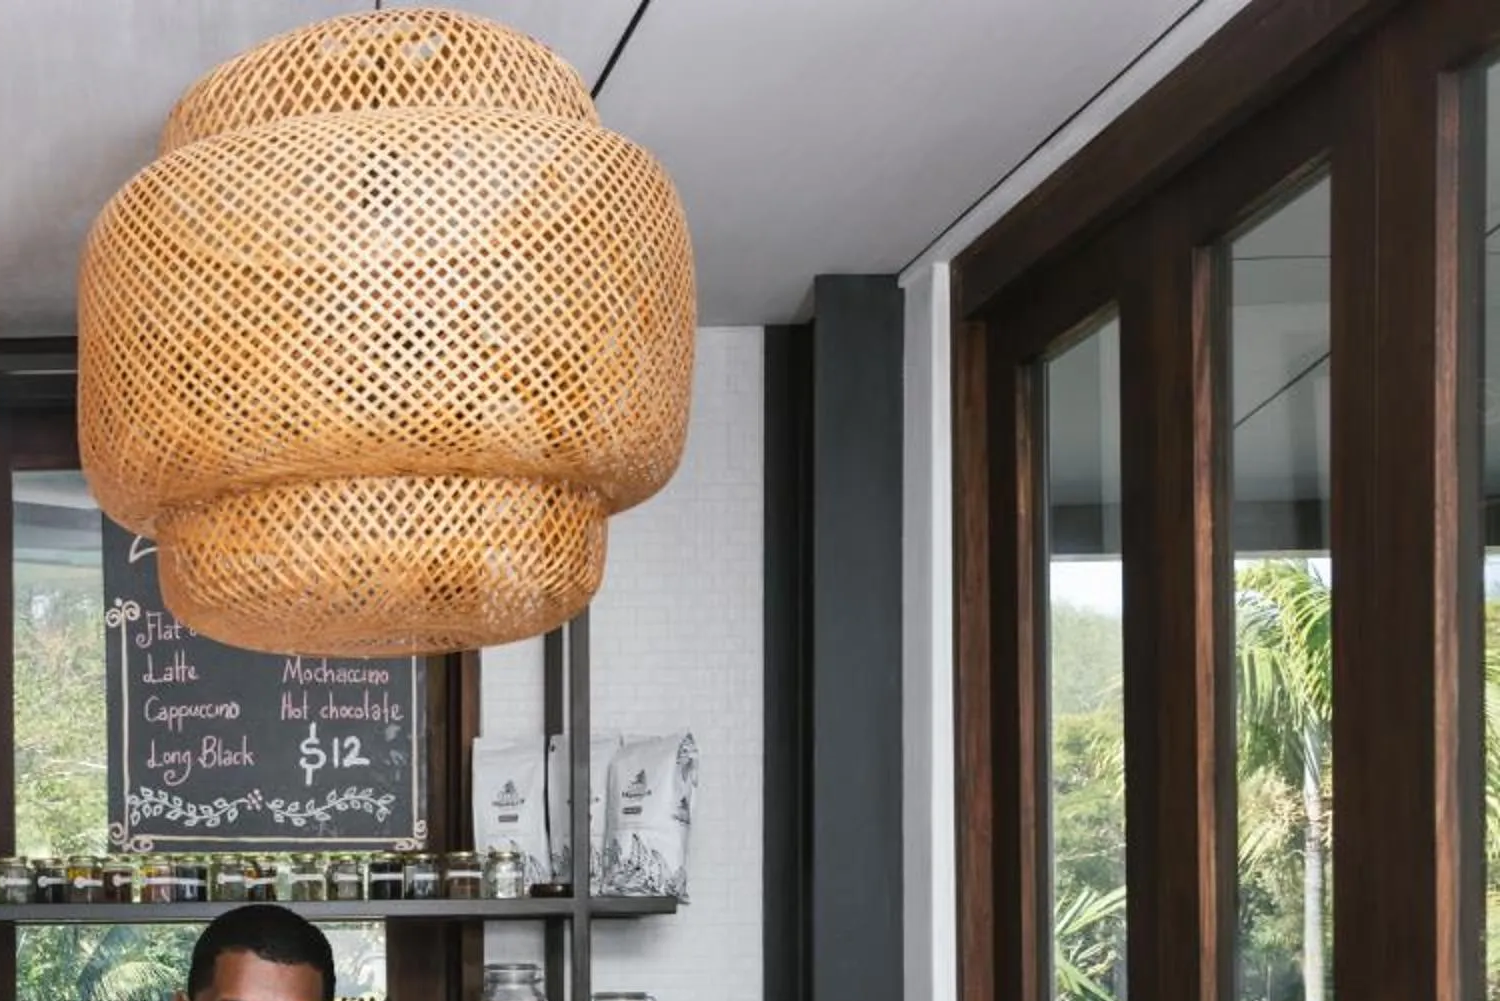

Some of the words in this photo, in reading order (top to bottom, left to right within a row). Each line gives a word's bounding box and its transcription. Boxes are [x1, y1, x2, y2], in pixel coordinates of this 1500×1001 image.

[136, 611, 182, 648] Flat
[143, 648, 200, 684] Latte
[281, 689, 308, 721] Hot
[319, 687, 405, 725] chocolate
[146, 738, 192, 787] Long
[197, 734, 255, 769] Black
[299, 720, 371, 786] $12
